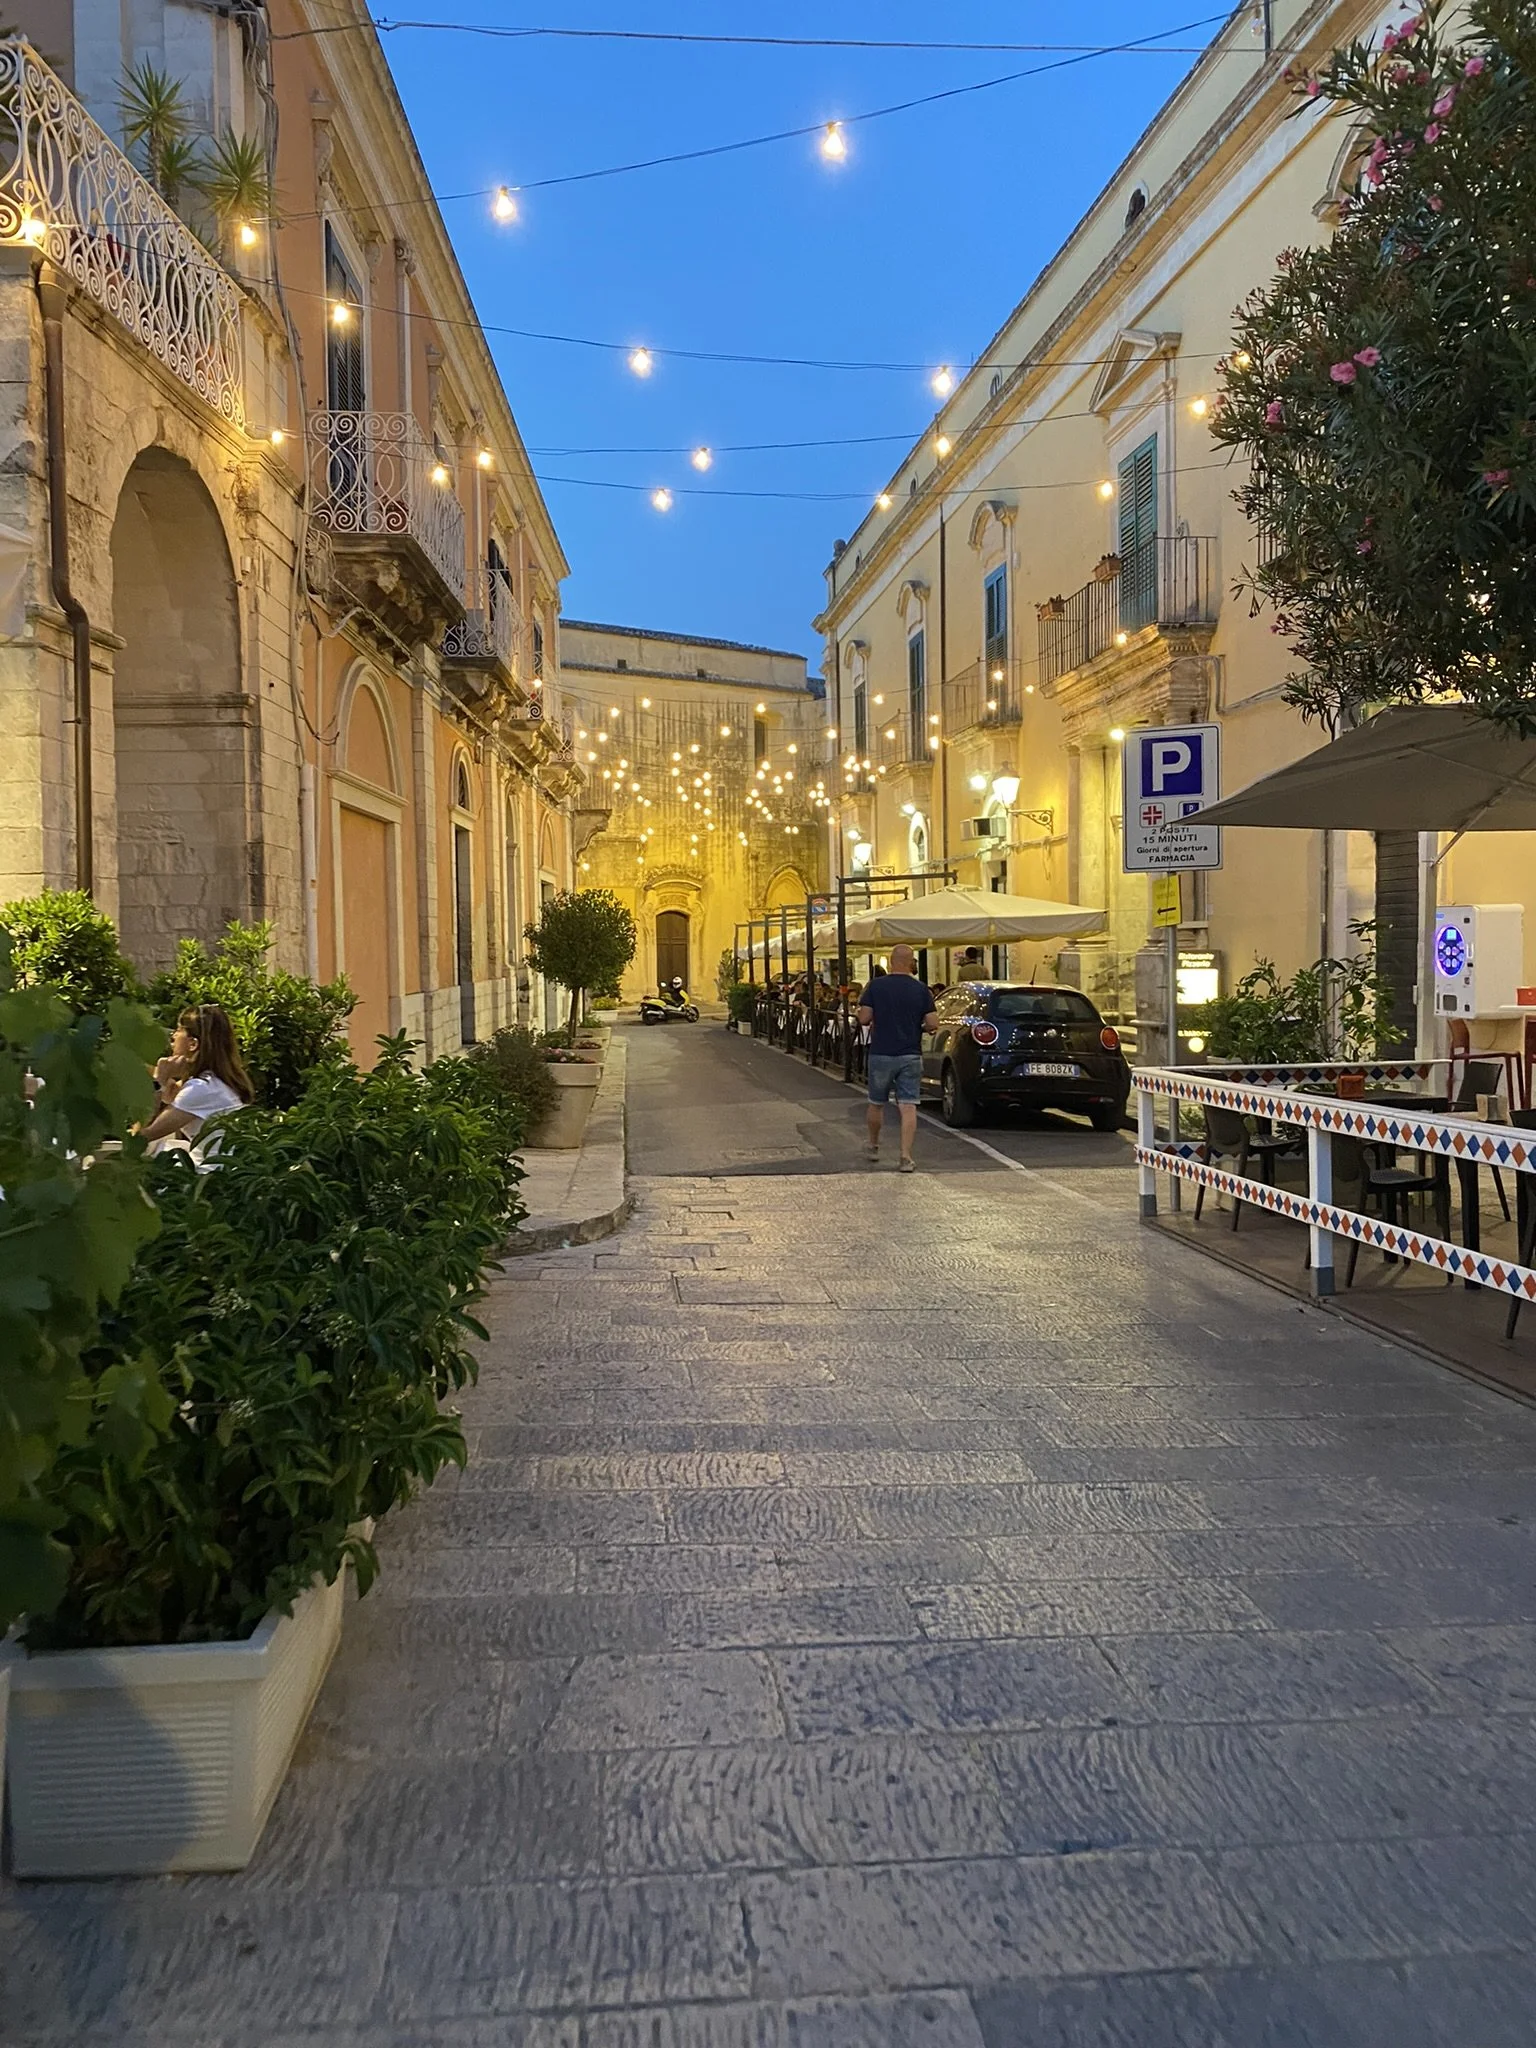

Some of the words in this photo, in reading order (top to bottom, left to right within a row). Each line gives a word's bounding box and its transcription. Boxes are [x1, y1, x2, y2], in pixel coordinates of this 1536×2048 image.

[1152, 741, 1191, 792] P
[1143, 836, 1155, 844] 15
[1158, 834, 1197, 843] MINUTI
[1136, 846, 1160, 854] Giorni
[1174, 845, 1208, 853] apertura
[1149, 854, 1195, 863] FARMACIA
[1031, 1063, 1042, 1073] FE
